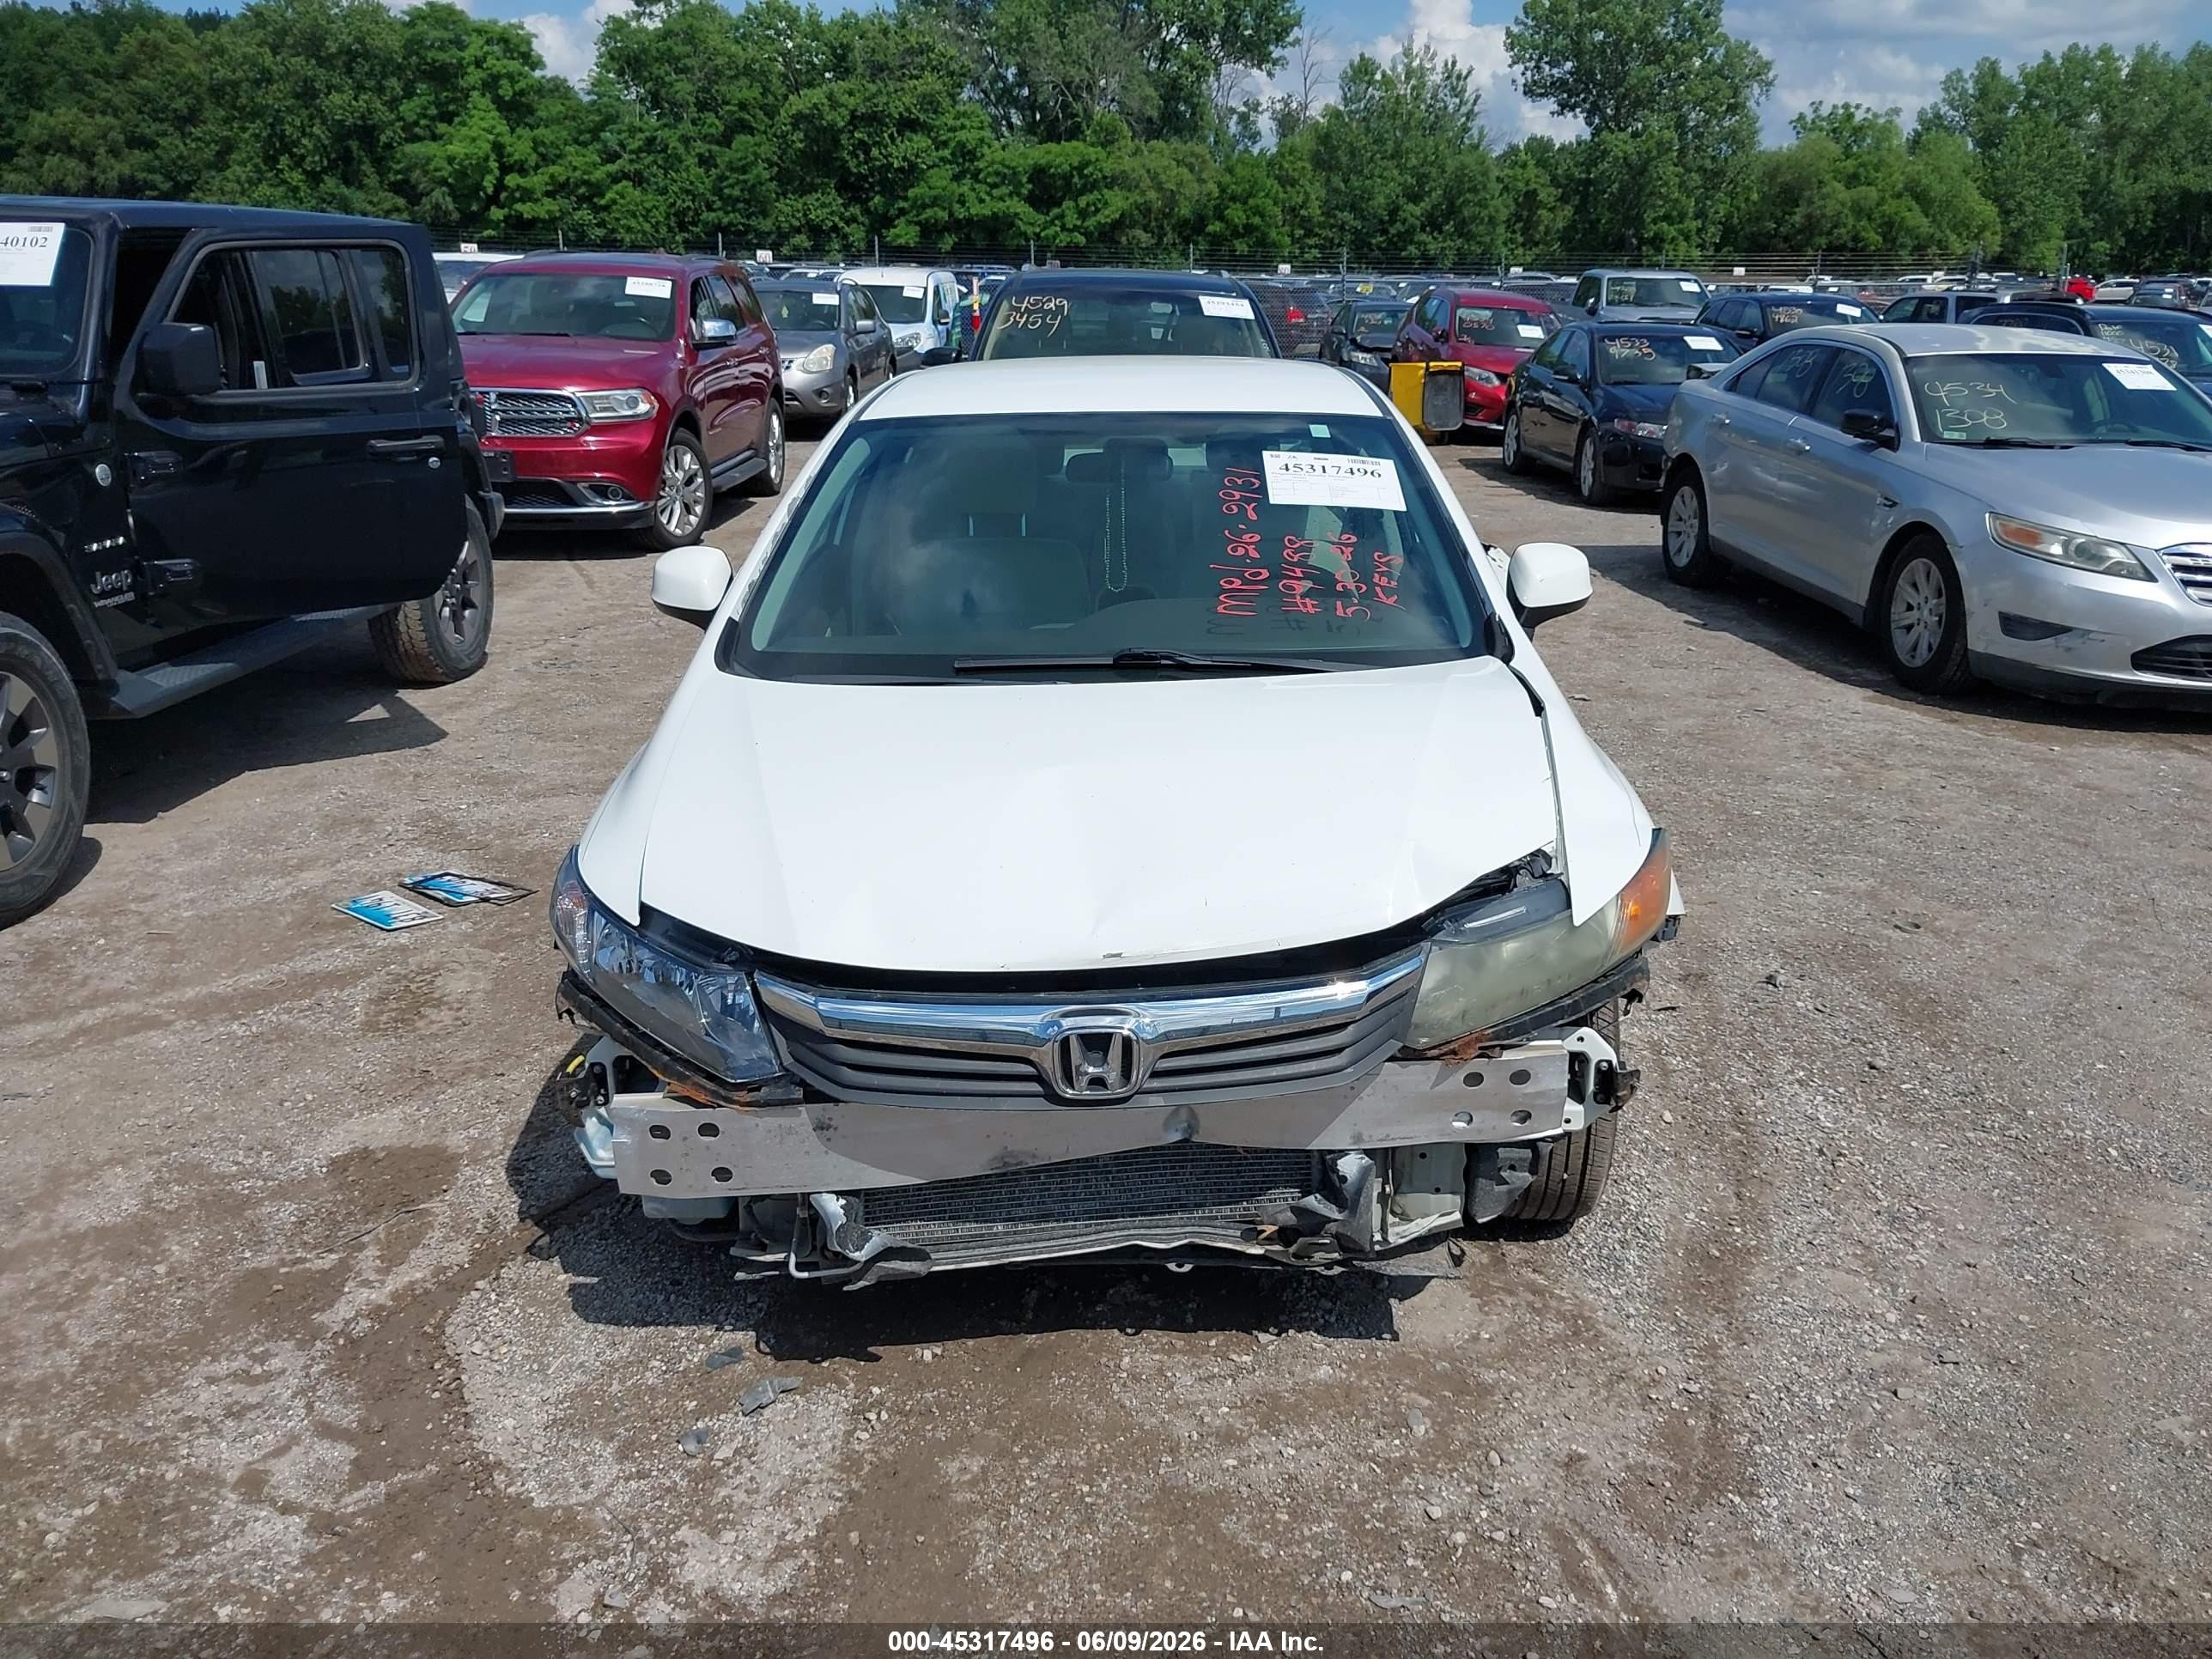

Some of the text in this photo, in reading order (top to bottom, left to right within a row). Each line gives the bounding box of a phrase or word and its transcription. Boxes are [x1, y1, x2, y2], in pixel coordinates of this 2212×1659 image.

[1012, 296, 1068, 316] 4529
[997, 312, 1061, 337] 3454
[1604, 337, 1650, 349] 4533
[1924, 381, 2017, 406] 4534
[1936, 407, 2007, 433] 1308
[1279, 462, 1382, 478] 45317496
[90, 569, 132, 594] Jeep
